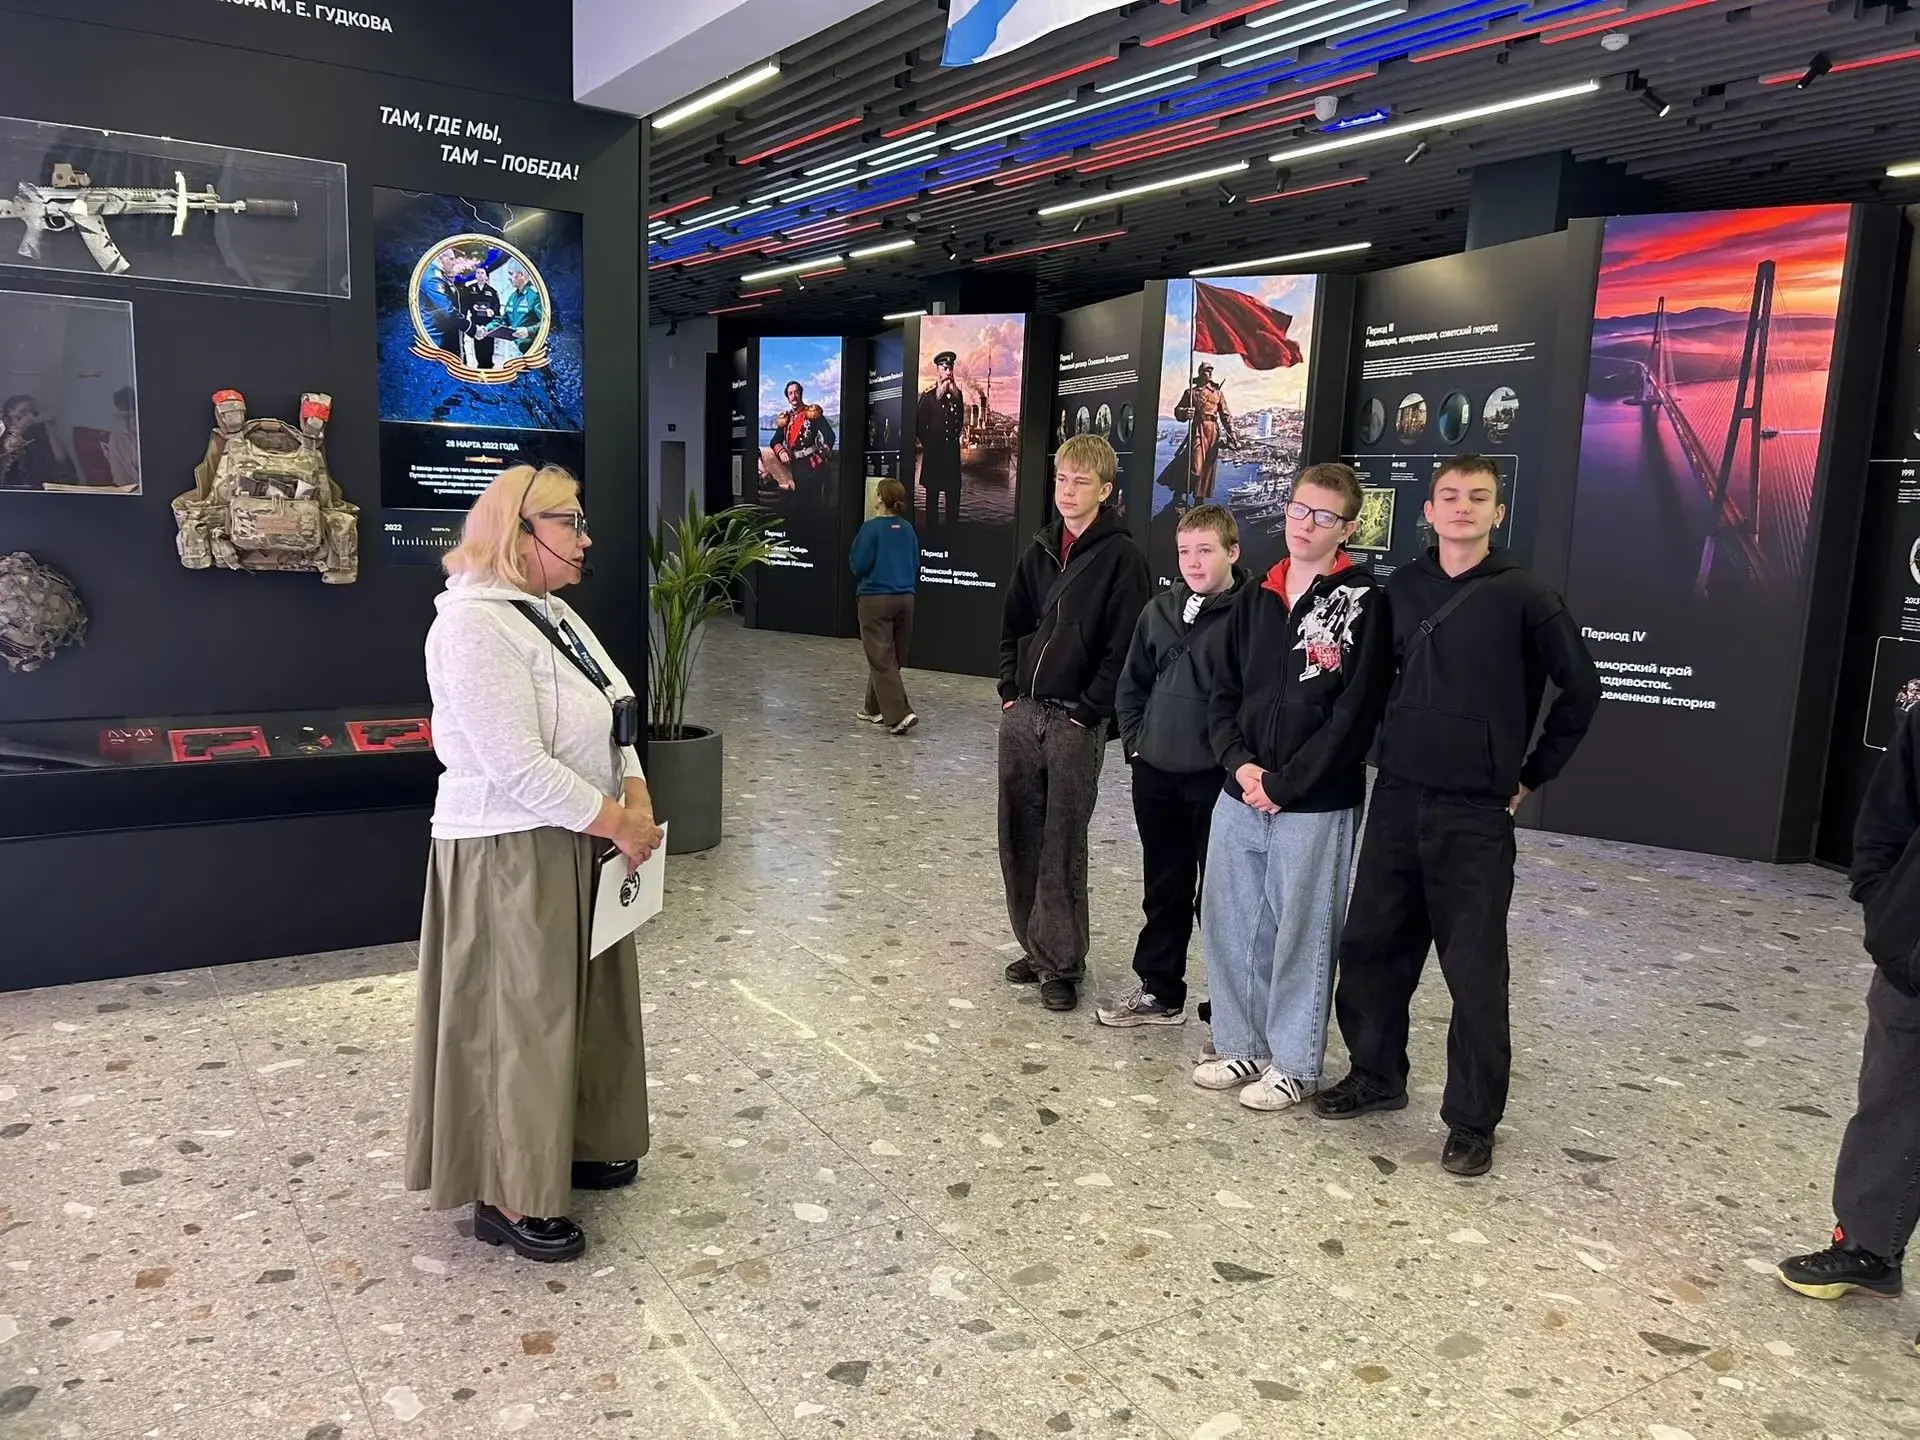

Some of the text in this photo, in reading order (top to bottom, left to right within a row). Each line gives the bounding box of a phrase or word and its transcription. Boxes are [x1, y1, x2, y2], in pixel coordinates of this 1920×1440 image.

[296, 1, 312, 17] Е.
[315, 4, 393, 33] ГУДКОВА
[379, 105, 503, 145] ТАМ, ГДЕ МЫ,
[440, 144, 480, 167] ТАМ
[501, 153, 581, 182] ПОБЕДА!
[456, 440, 481, 448] МАРТА
[500, 443, 519, 451] ГОДА
[384, 523, 403, 532] 2022
[921, 549, 943, 558] Период
[1581, 626, 1647, 642] Период IV
[1659, 666, 1693, 677] край
[1661, 696, 1716, 710] история
